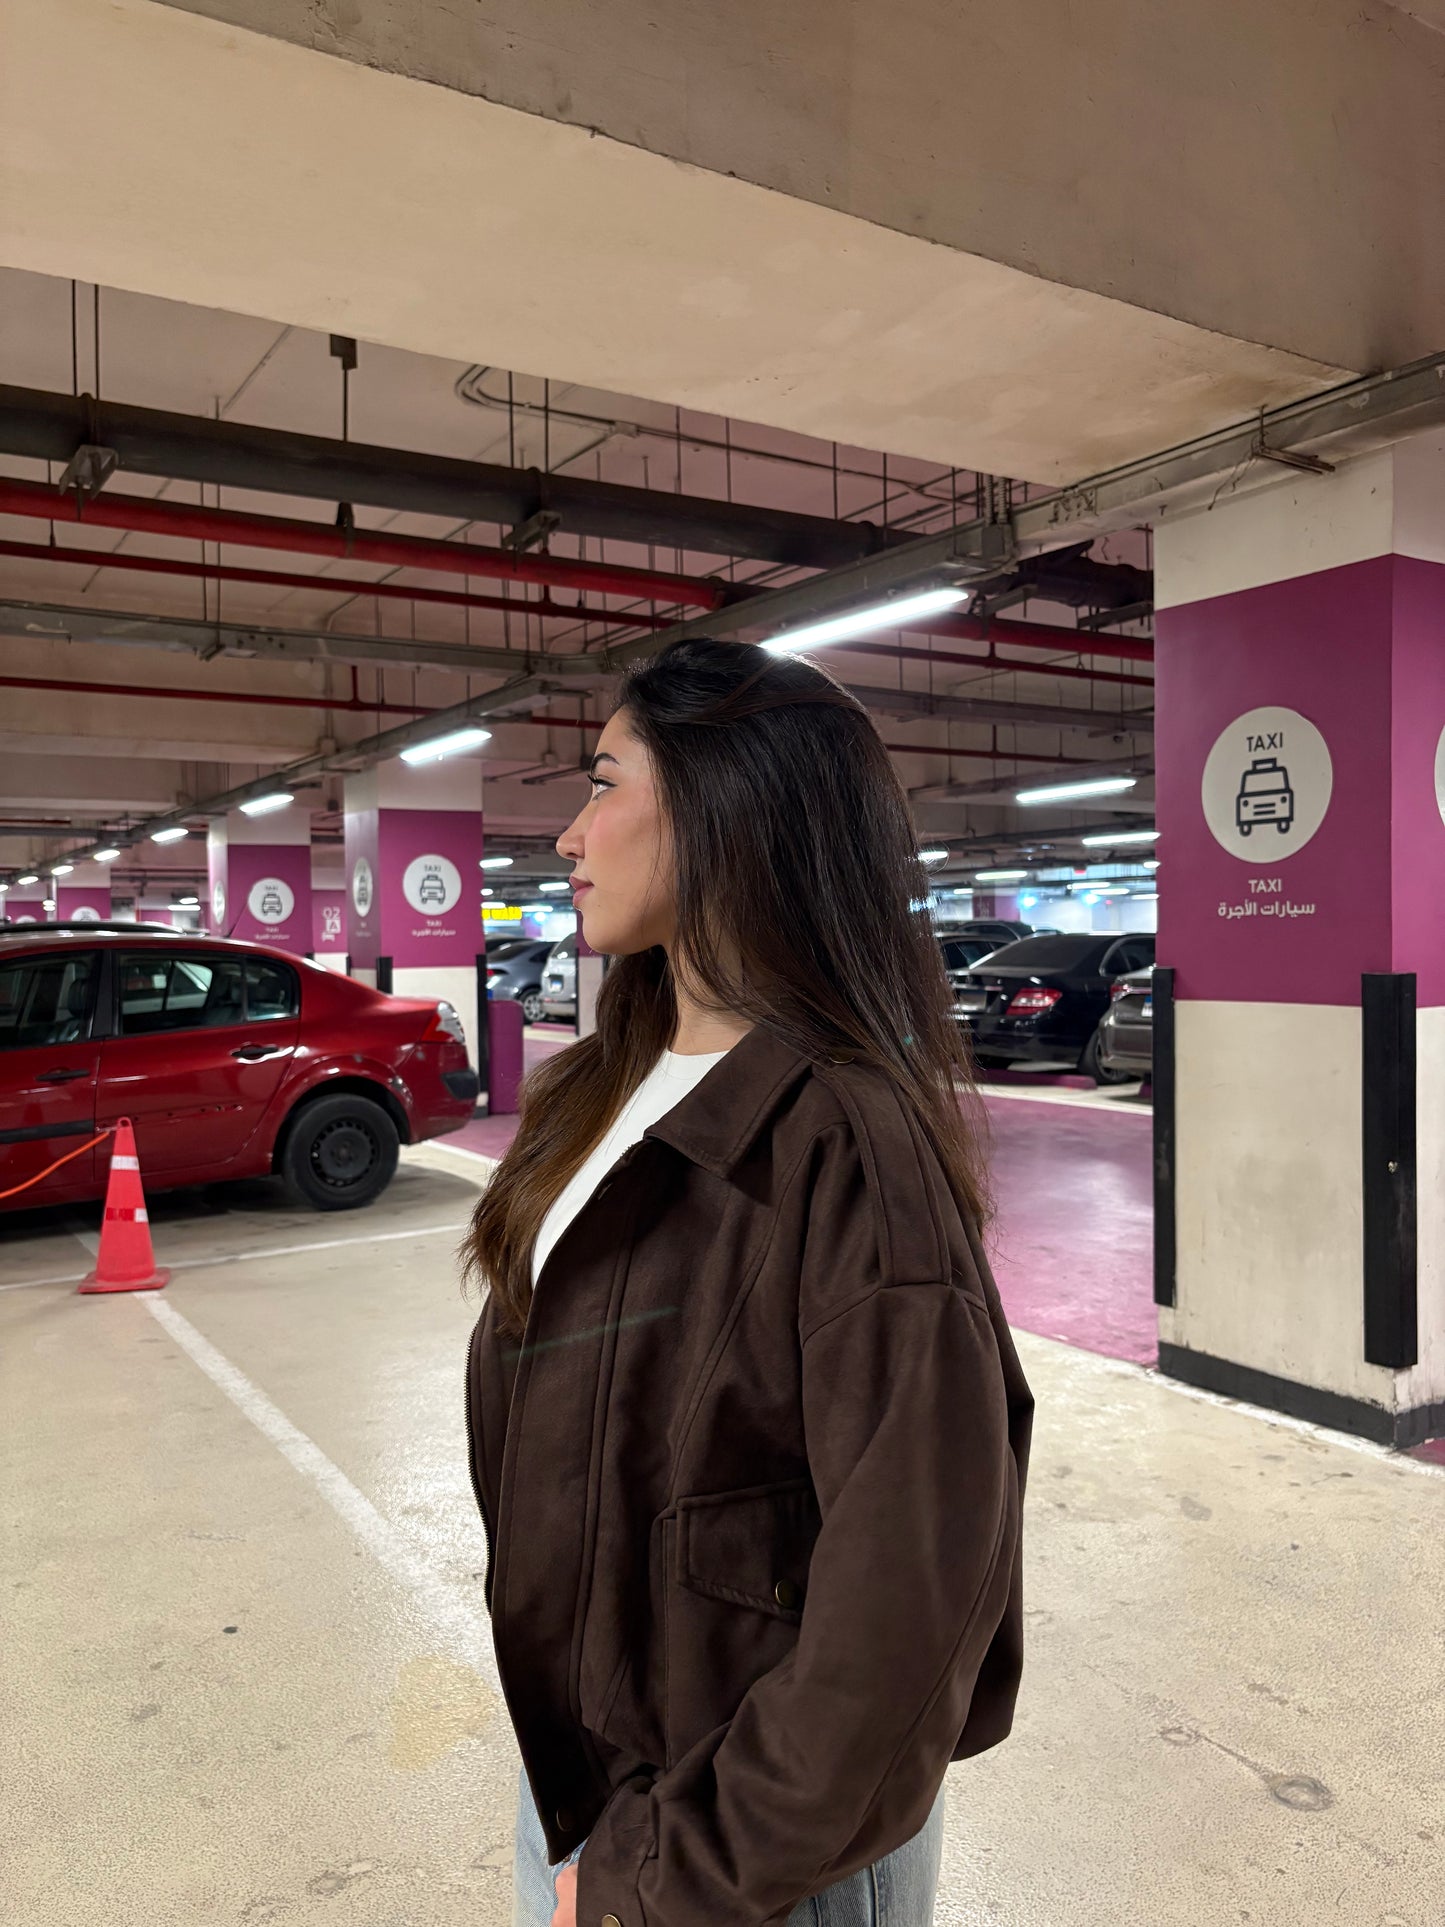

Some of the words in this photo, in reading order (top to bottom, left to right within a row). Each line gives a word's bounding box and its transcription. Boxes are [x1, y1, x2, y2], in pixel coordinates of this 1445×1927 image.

[1246, 732, 1284, 752] TAXI
[1248, 879, 1282, 893] TAXI
[1217, 899, 1258, 919] الأجرة
[1260, 900, 1316, 918] سيارات
